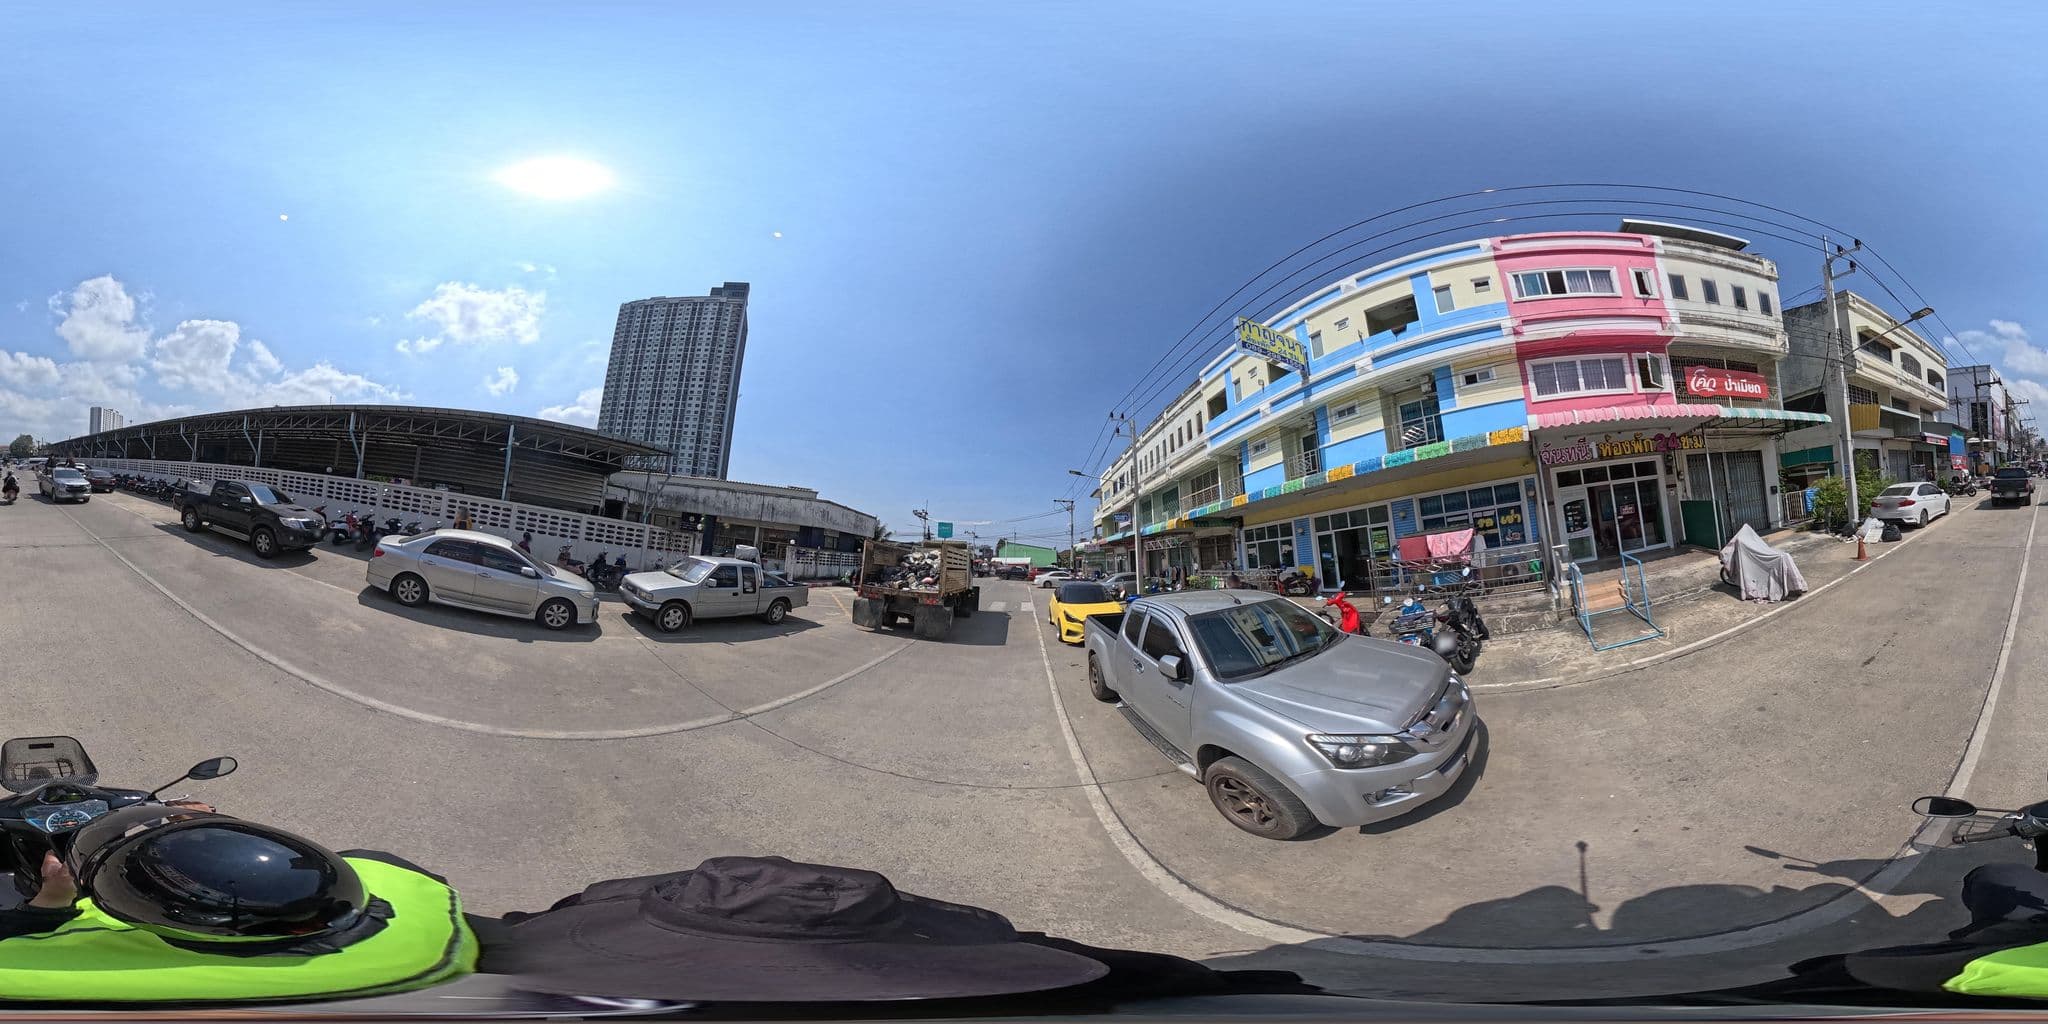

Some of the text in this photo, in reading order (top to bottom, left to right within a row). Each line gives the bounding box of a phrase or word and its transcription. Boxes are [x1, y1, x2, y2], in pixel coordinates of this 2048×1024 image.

[1240, 320, 1303, 354] กาญจนา
[1599, 432, 1654, 458] ห้องพัก
[1654, 432, 1680, 453] 24
